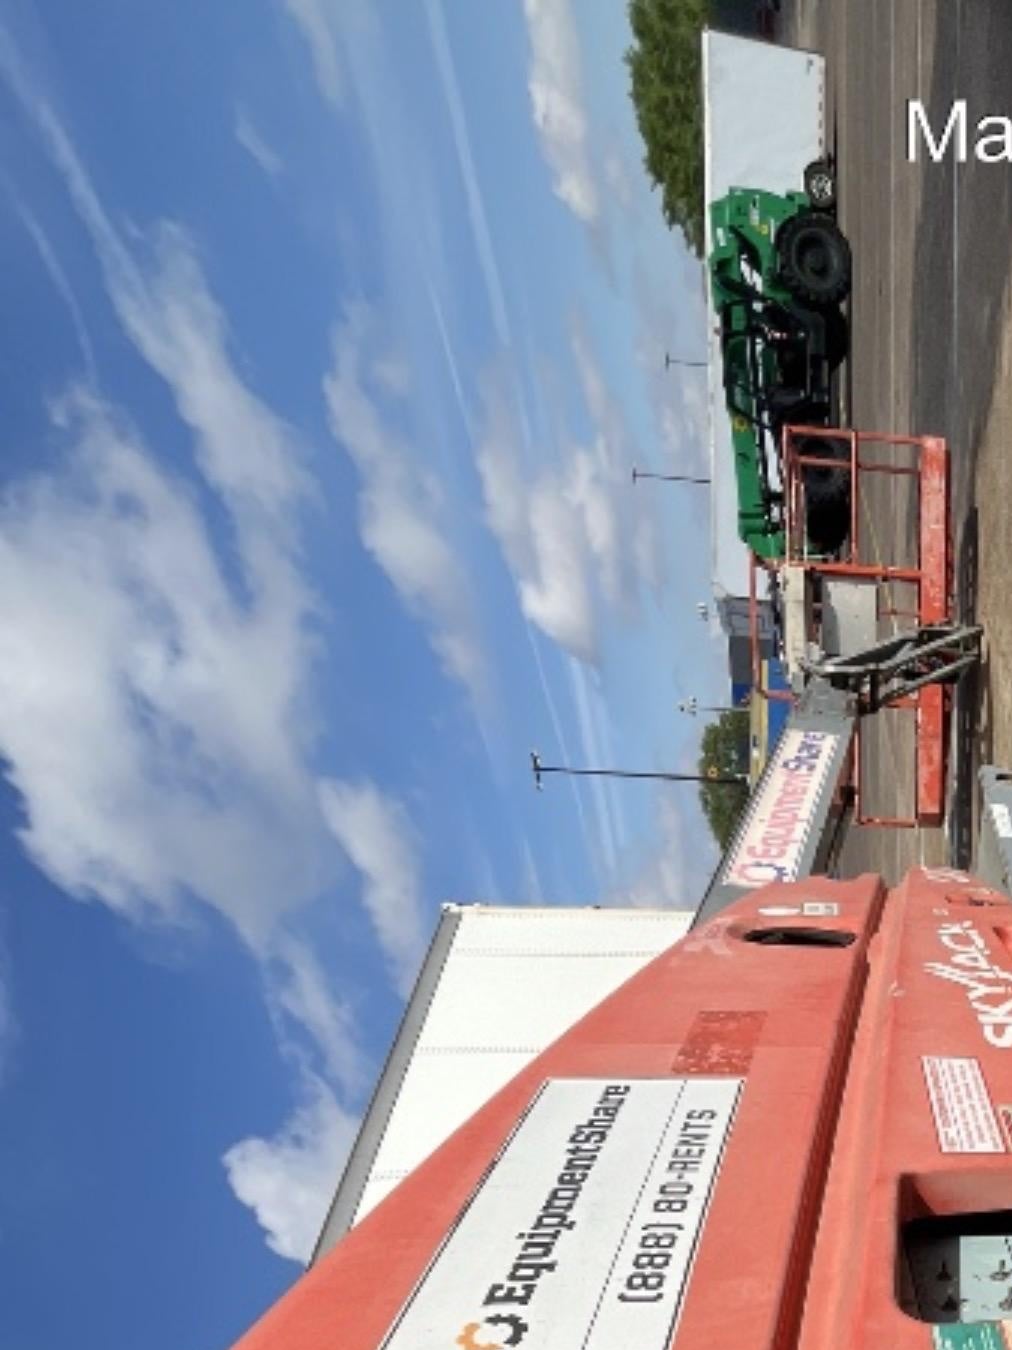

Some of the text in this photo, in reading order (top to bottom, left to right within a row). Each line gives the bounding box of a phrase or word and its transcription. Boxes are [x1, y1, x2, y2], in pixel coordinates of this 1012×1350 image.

[746, 730, 827, 859] EquipmentShare
[482, 1084, 631, 1307] EquipmentShare
[617, 1108, 718, 1303] (888) 80-RENTS
